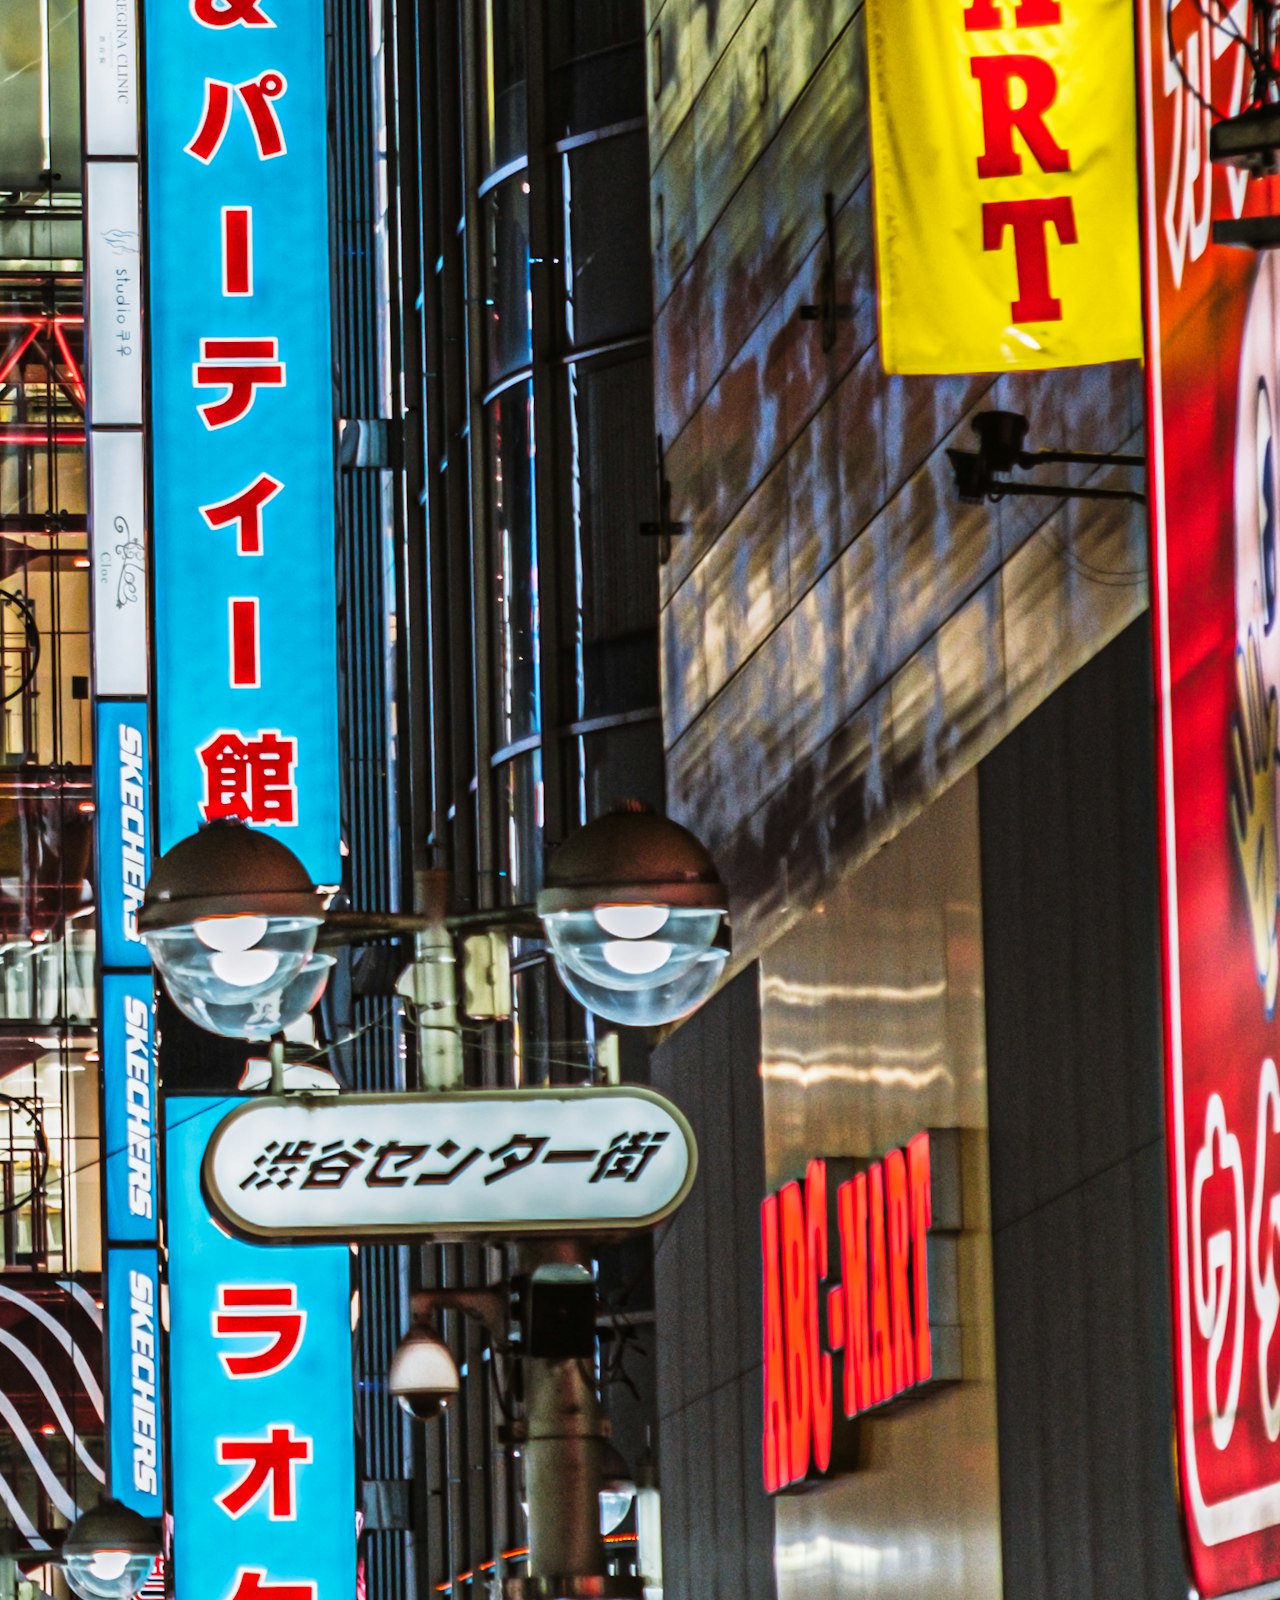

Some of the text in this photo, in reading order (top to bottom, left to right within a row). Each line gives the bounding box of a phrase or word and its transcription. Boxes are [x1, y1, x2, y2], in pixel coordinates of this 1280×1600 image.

[115, 268, 132, 324] studio
[119, 721, 148, 963] SKECHERS
[125, 995, 153, 1224] SKECHERS
[240, 1131, 670, 1191] 渋谷センター街
[128, 1269, 157, 1497] SKECHERS
